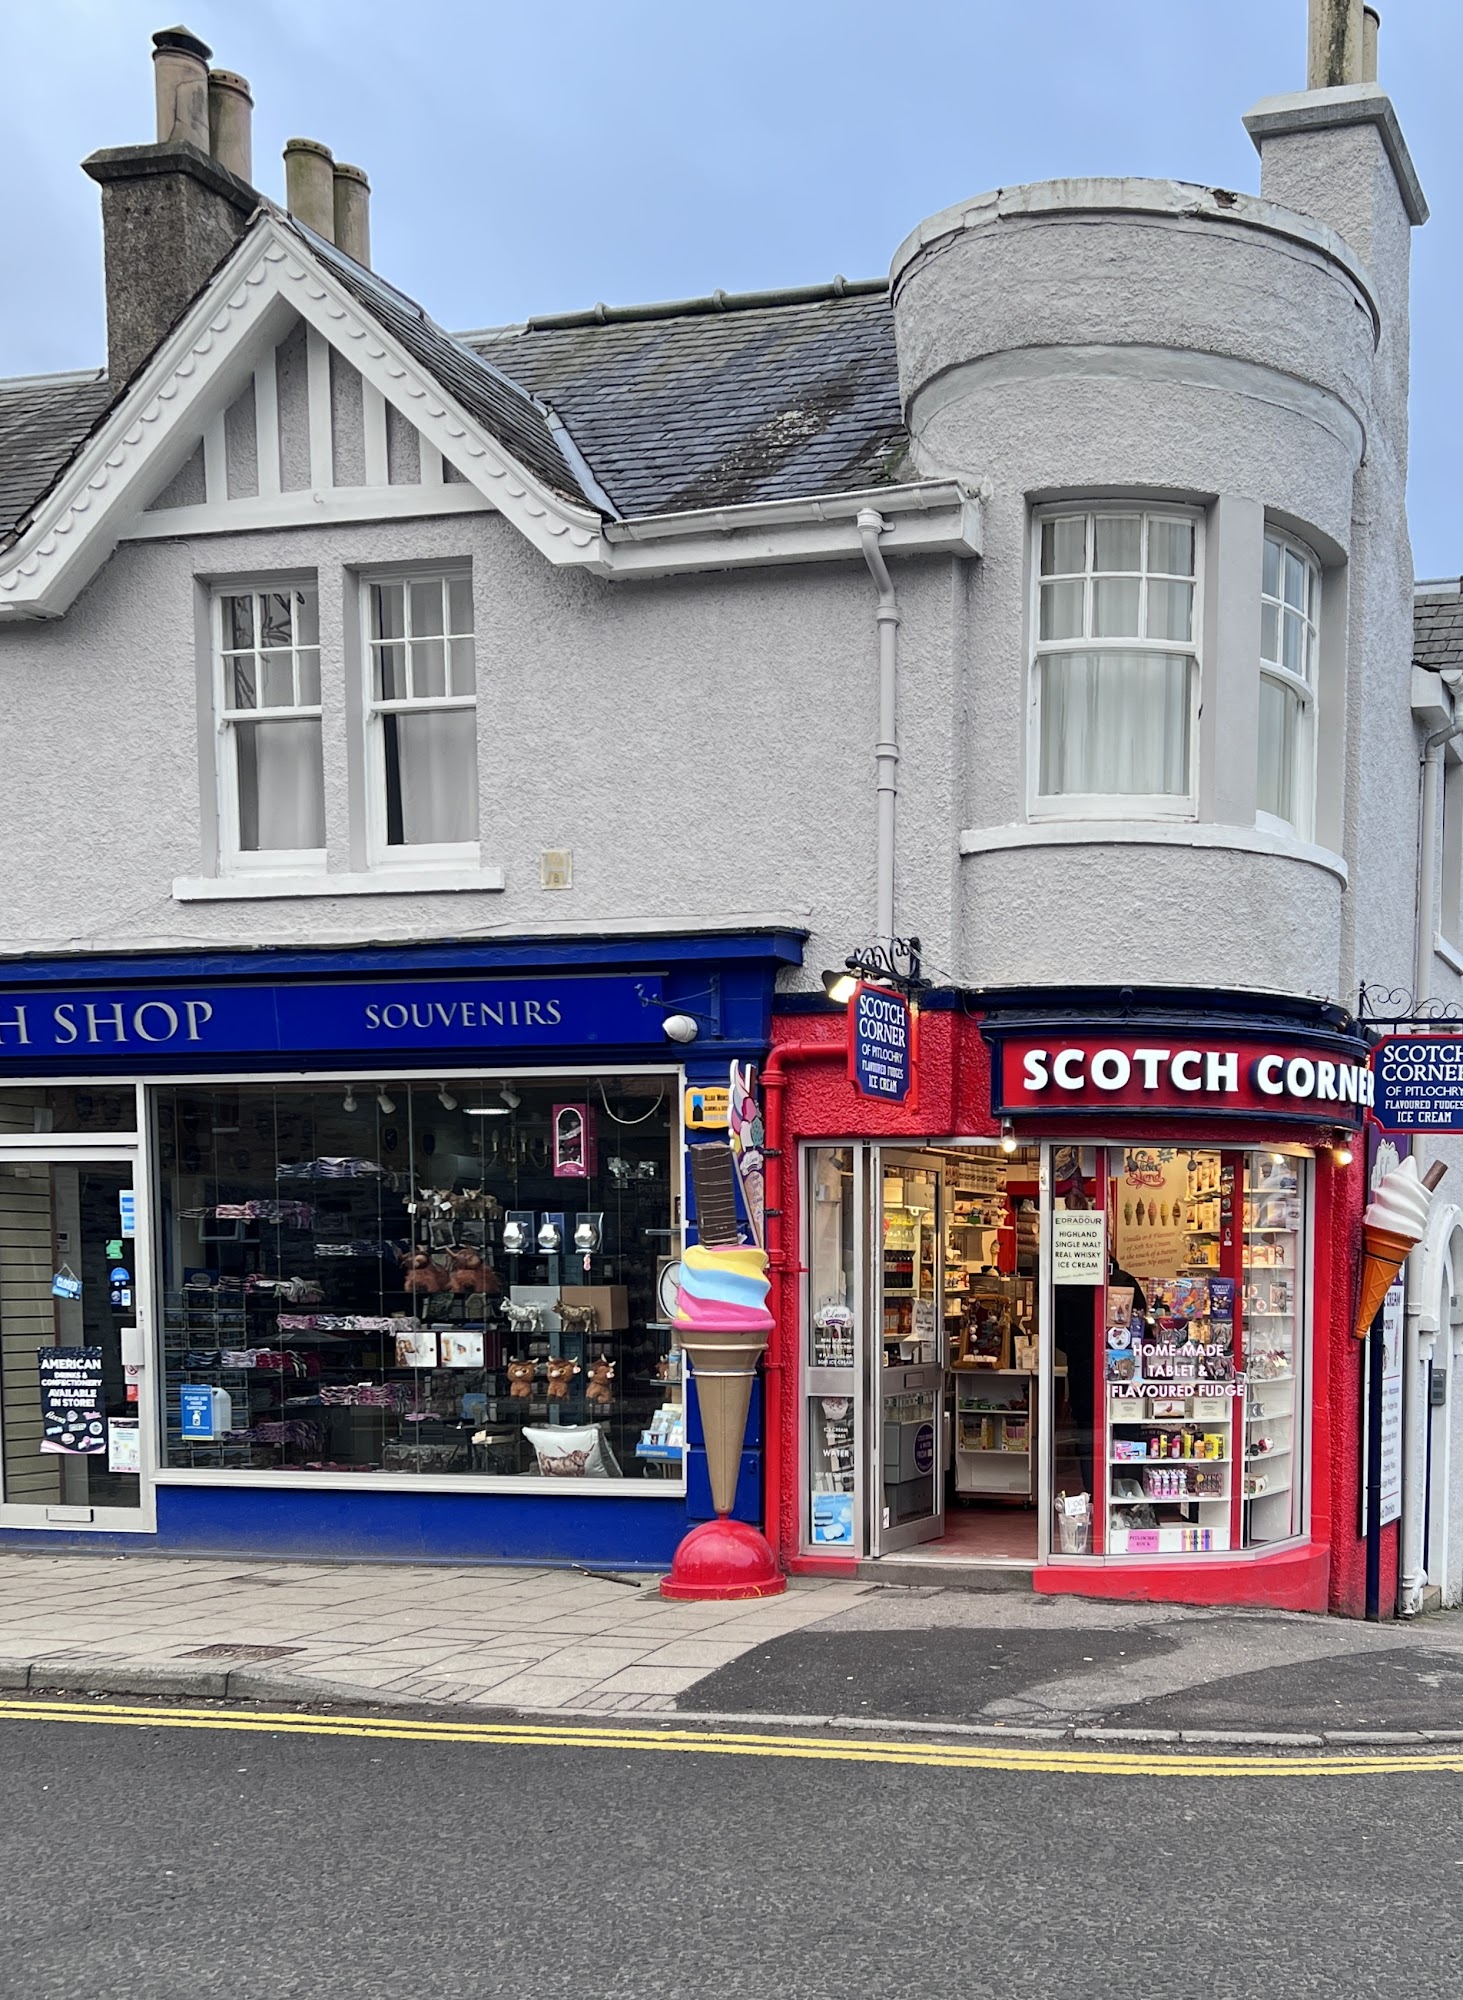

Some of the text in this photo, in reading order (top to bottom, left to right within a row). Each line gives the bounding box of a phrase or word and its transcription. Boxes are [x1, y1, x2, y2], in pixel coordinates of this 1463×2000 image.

[365, 1000, 561, 1029] SOUVENIRS
[860, 995, 905, 1026] SCOTCH
[54, 1001, 213, 1044] SHOP
[859, 1017, 906, 1048] CORNER
[861, 1043, 903, 1064] OF PITLOCHRY
[868, 1074, 897, 1093] ICE CREAM
[1023, 1049, 1375, 1108] SCOTCH CORNER
[1386, 1086, 1402, 1096] OF
[1385, 1100, 1431, 1110] FLAVOURED
[1397, 1111, 1452, 1123] ICE CREAM
[1055, 1217, 1102, 1225] EDRADOUR
[1133, 1344, 1224, 1357] HOME-MADE
[40, 1359, 102, 1370] AMERICAN
[54, 1371, 88, 1379] DRINKS &
[1148, 1365, 1208, 1377] TABLET &
[41, 1379, 103, 1387] CONFECTIONERY
[48, 1389, 97, 1398] AVAILABLE
[1112, 1384, 1244, 1397] FLAVOURED FUDGE
[50, 1398, 95, 1407] IN STORE!
[823, 1449, 849, 1458] WATER
